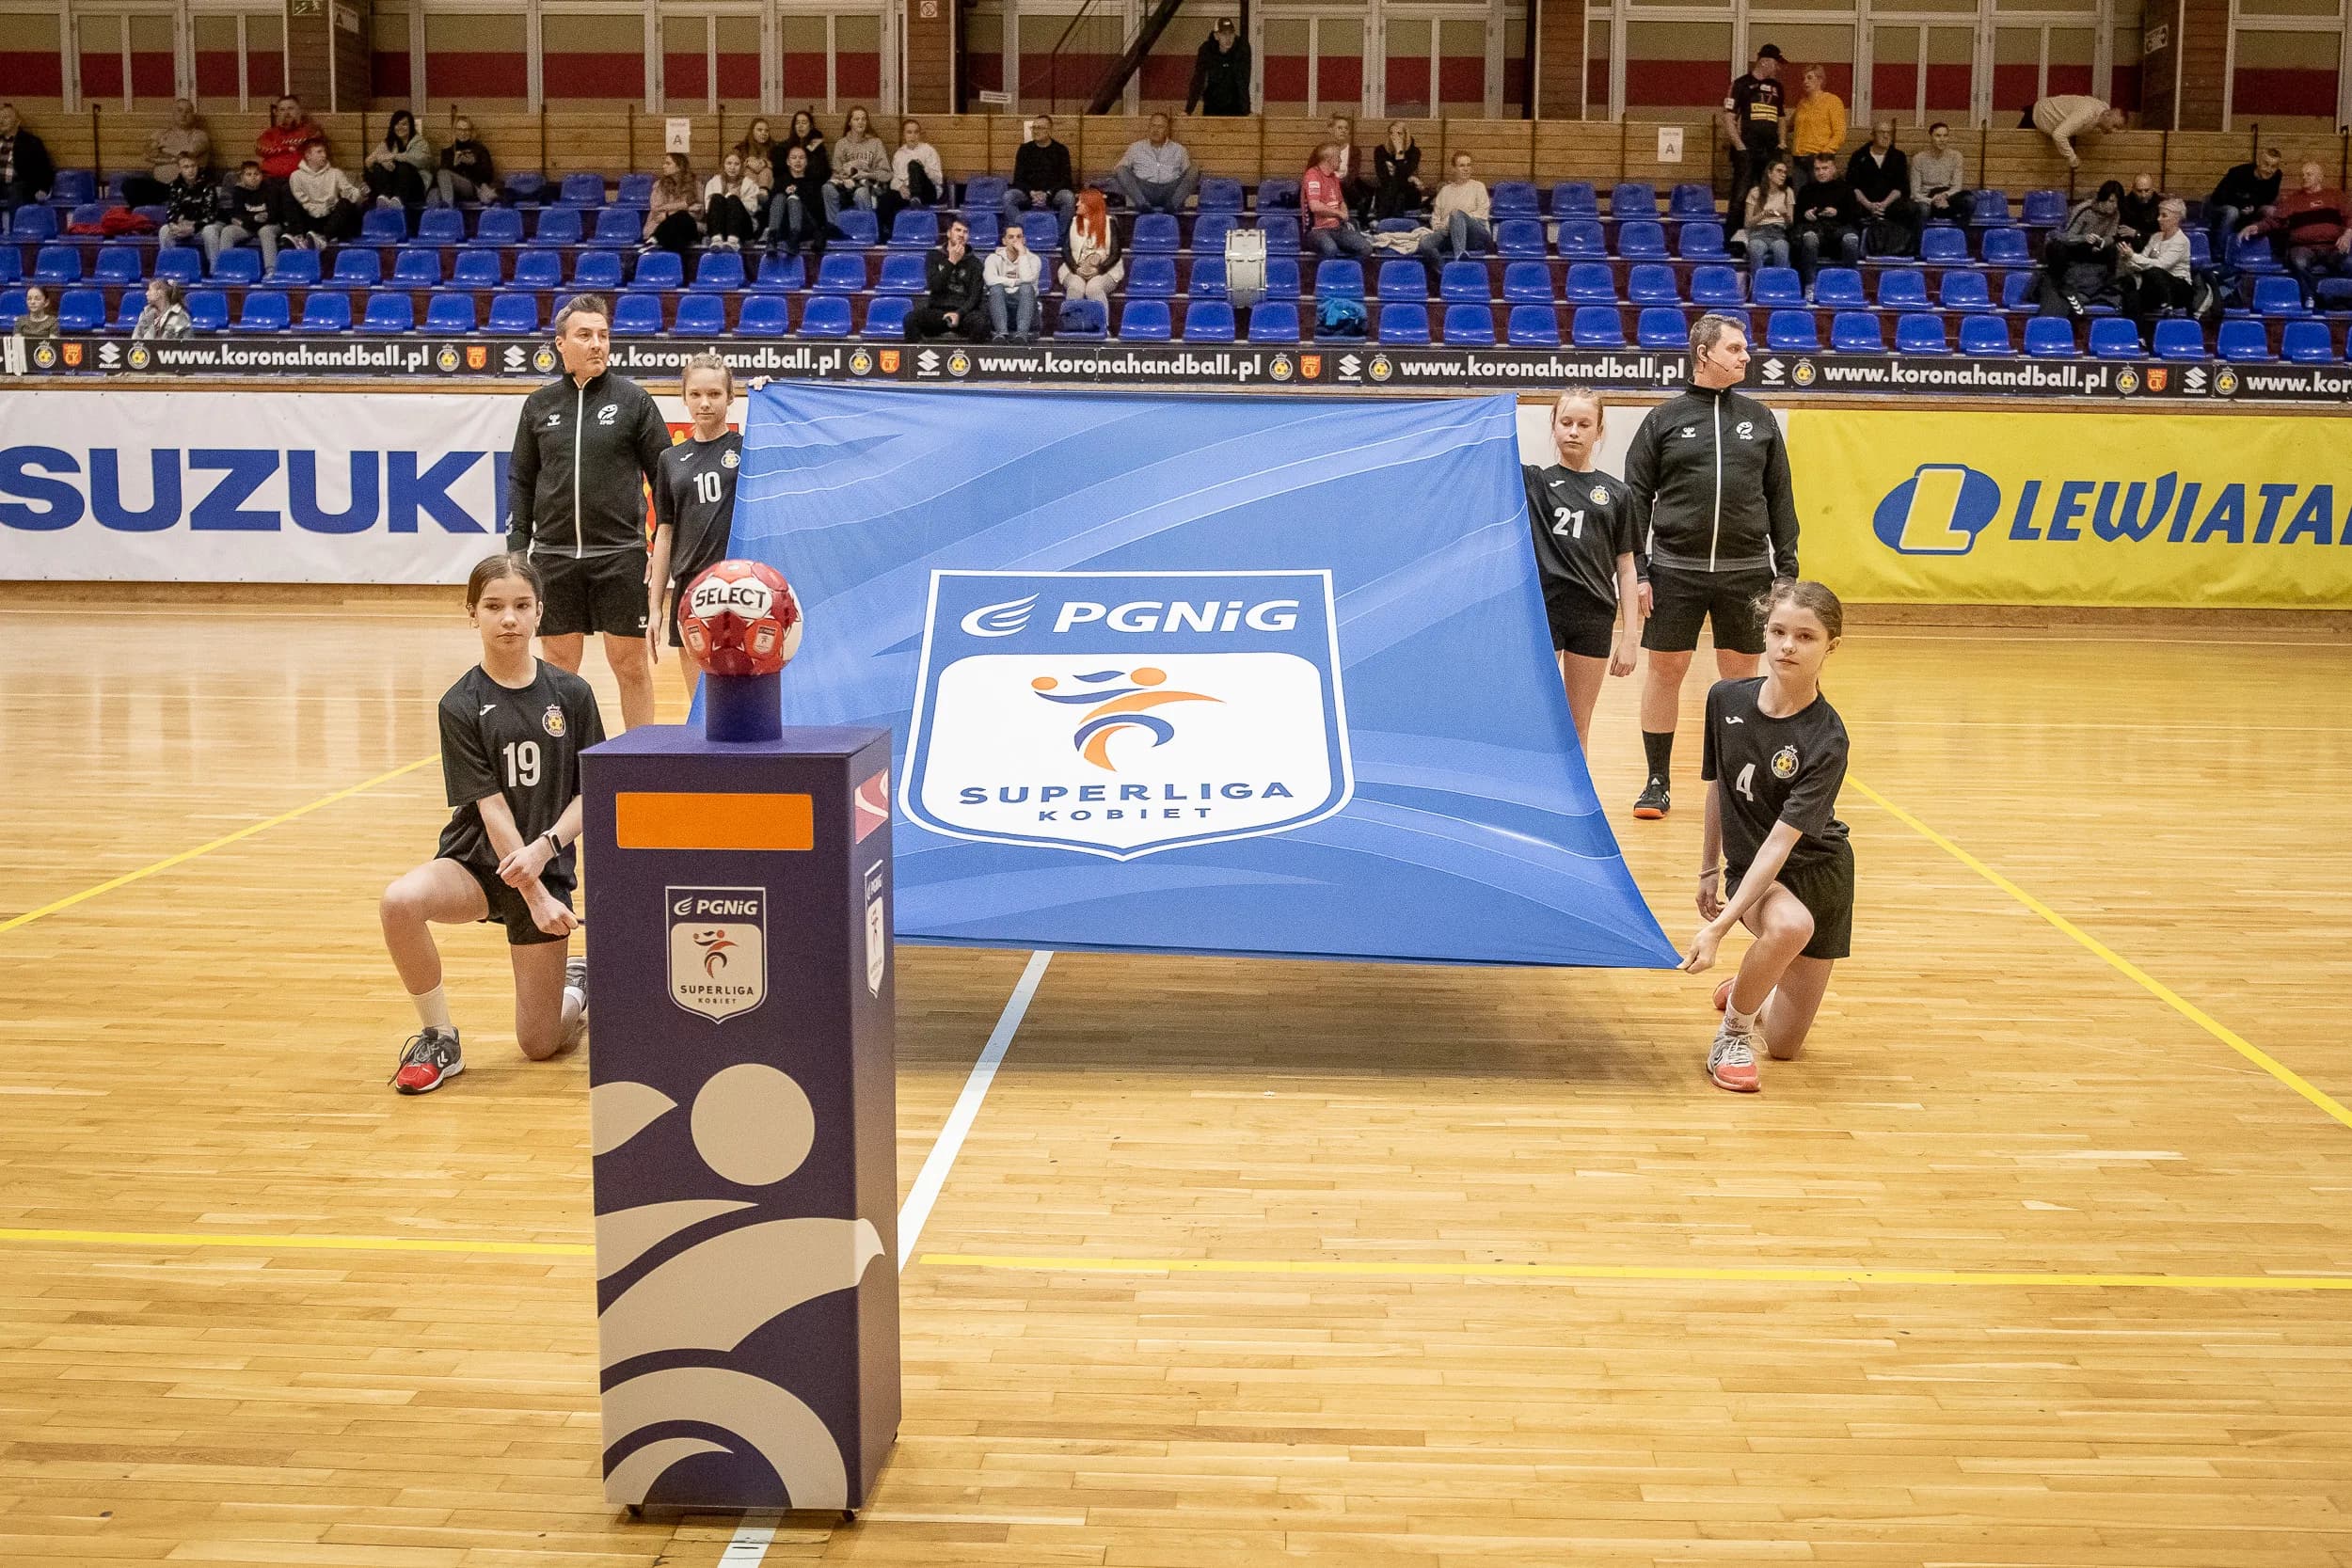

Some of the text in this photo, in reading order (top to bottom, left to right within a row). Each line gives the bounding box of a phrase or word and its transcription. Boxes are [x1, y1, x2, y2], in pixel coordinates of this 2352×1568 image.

[673, 135, 683, 146] A
[1665, 143, 1676, 154] A
[157, 343, 429, 372] www.koronahandball.pl
[978, 352, 1261, 381] www.koronahandball.pl
[1303, 365, 1318, 377] CK
[1400, 355, 1684, 385] www.koronahandball.pl
[1823, 361, 2107, 393] www.koronahandball.pl
[693, 471, 722, 504] 10
[2009, 471, 2352, 545] LEWIATA
[1552, 506, 1585, 540] 21
[695, 587, 766, 610] SELECT
[1053, 599, 1300, 633] PGNiG
[502, 740, 541, 788] 19
[959, 782, 1294, 805] SUPERLIGA
[1736, 763, 1756, 802] 4
[1038, 807, 1213, 821] KOBIET
[696, 899, 758, 915] PGNiG
[680, 985, 755, 995] SUPERLIGA
